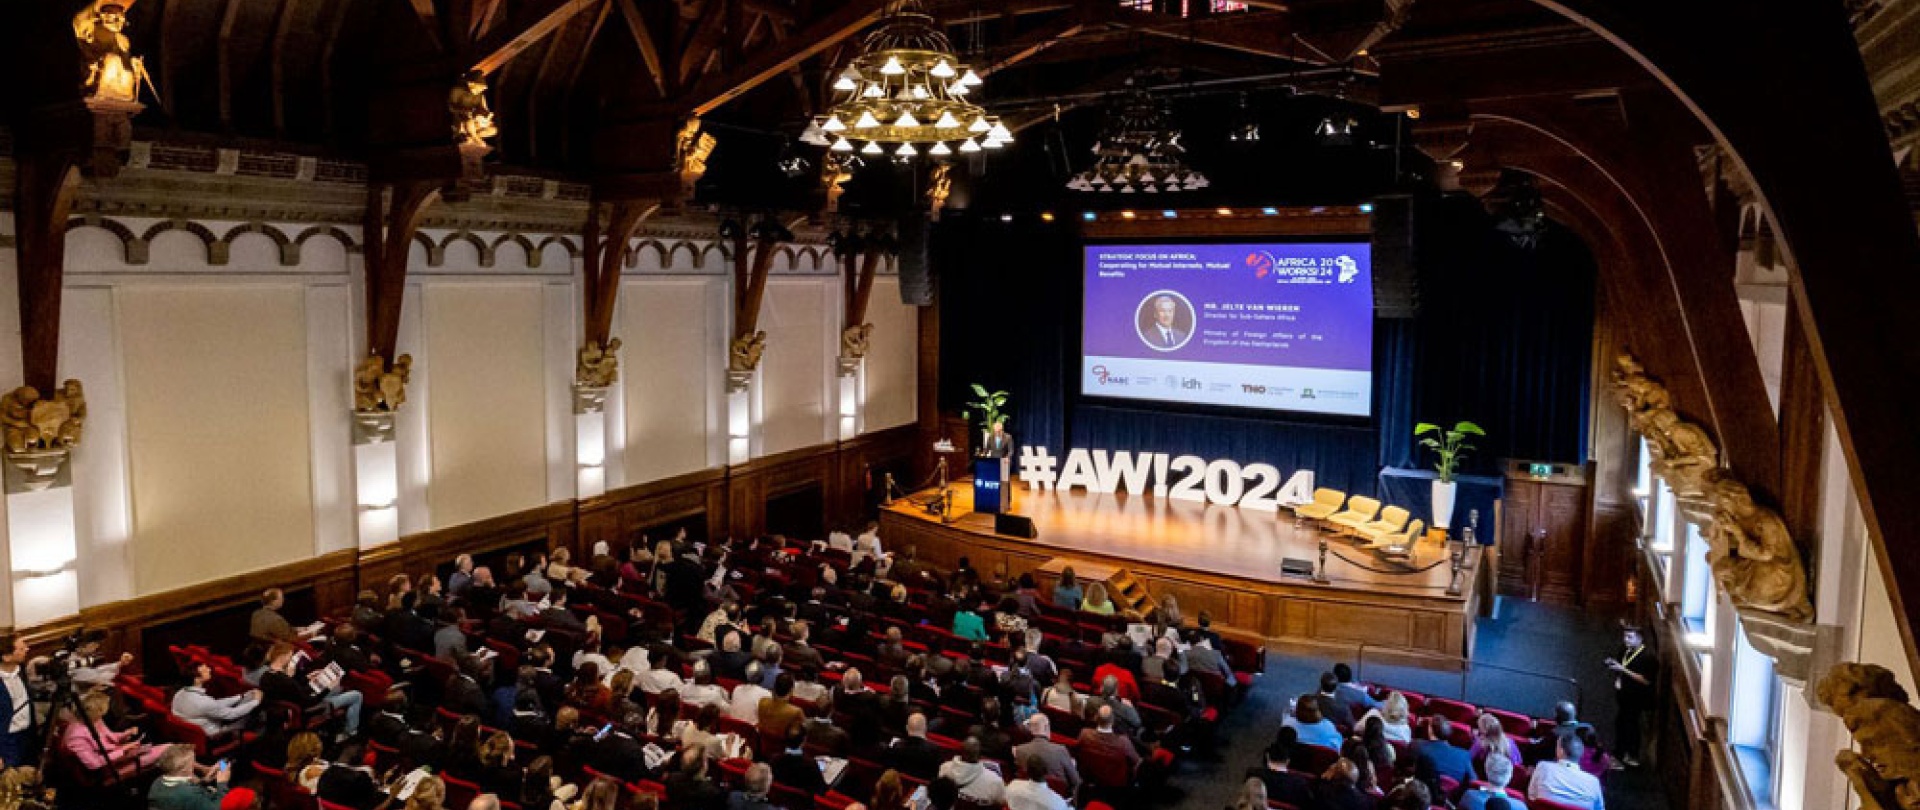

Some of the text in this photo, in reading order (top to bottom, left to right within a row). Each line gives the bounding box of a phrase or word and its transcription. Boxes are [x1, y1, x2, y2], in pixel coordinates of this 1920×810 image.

[1278, 257, 1333, 266] AFRICA 20
[1320, 267, 1333, 276] 24
[1246, 303, 1264, 311] VAN
[1182, 377, 1202, 390] idh
[1019, 446, 1315, 512] #AW!2024
